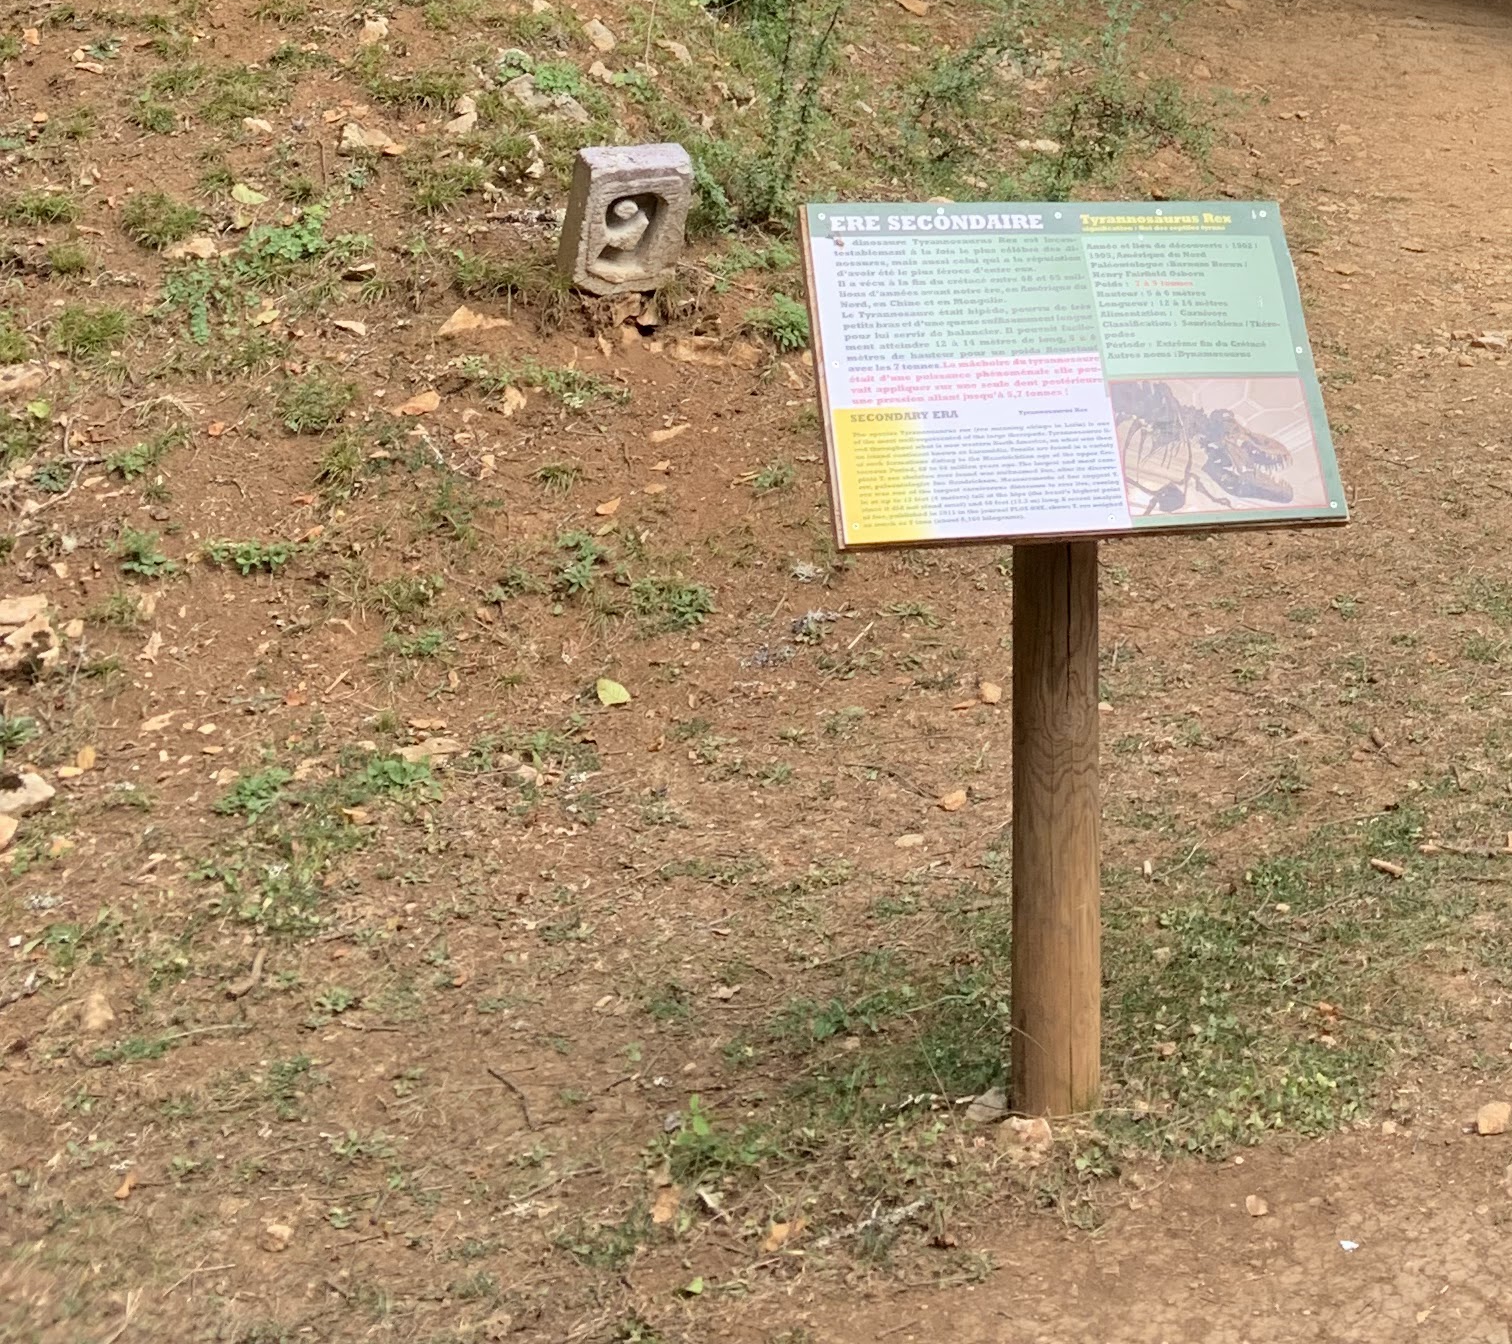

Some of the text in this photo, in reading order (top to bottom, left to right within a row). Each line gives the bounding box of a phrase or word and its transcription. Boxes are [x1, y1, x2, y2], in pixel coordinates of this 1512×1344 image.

[830, 214, 1044, 231] ERE SECONDAIRE
[1078, 213, 1232, 226] Tyrannosaurus Rex
[849, 409, 958, 422] SECONDARY ERA
